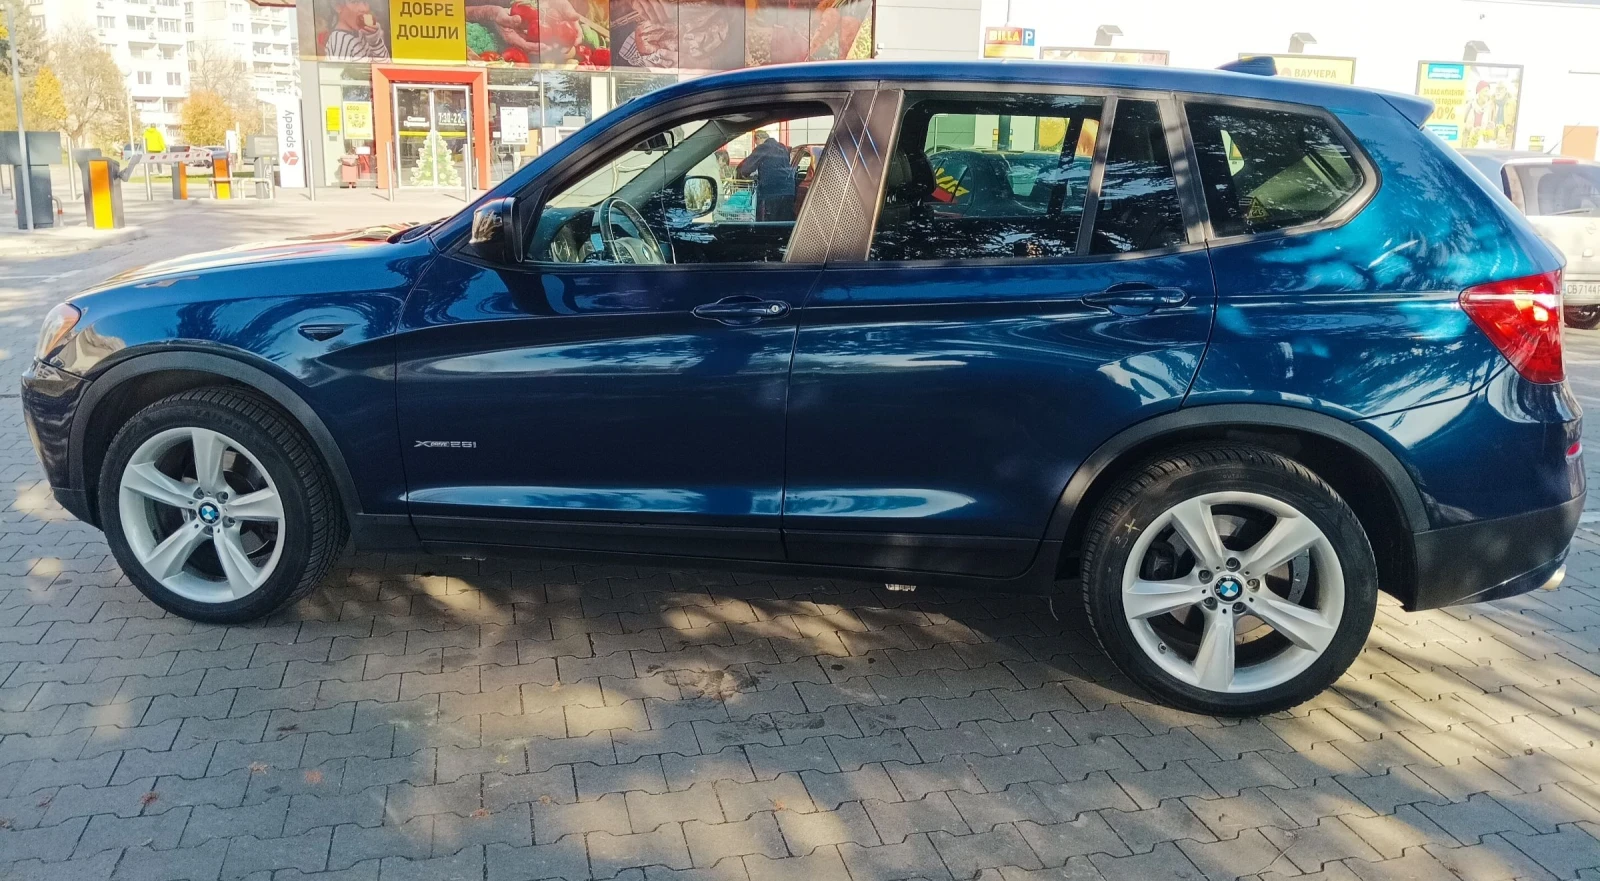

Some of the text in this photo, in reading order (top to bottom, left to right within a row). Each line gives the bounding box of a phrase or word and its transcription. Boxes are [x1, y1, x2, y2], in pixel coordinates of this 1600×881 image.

[400, 2, 454, 17] ДОБРЕ
[396, 24, 459, 40] ДОШЛИ
[988, 29, 1034, 44] BILLA P
[1294, 68, 1337, 79] ВАУЧЕРА
[282, 110, 296, 148] speedy
[1251, 209, 1264, 217] GAS
